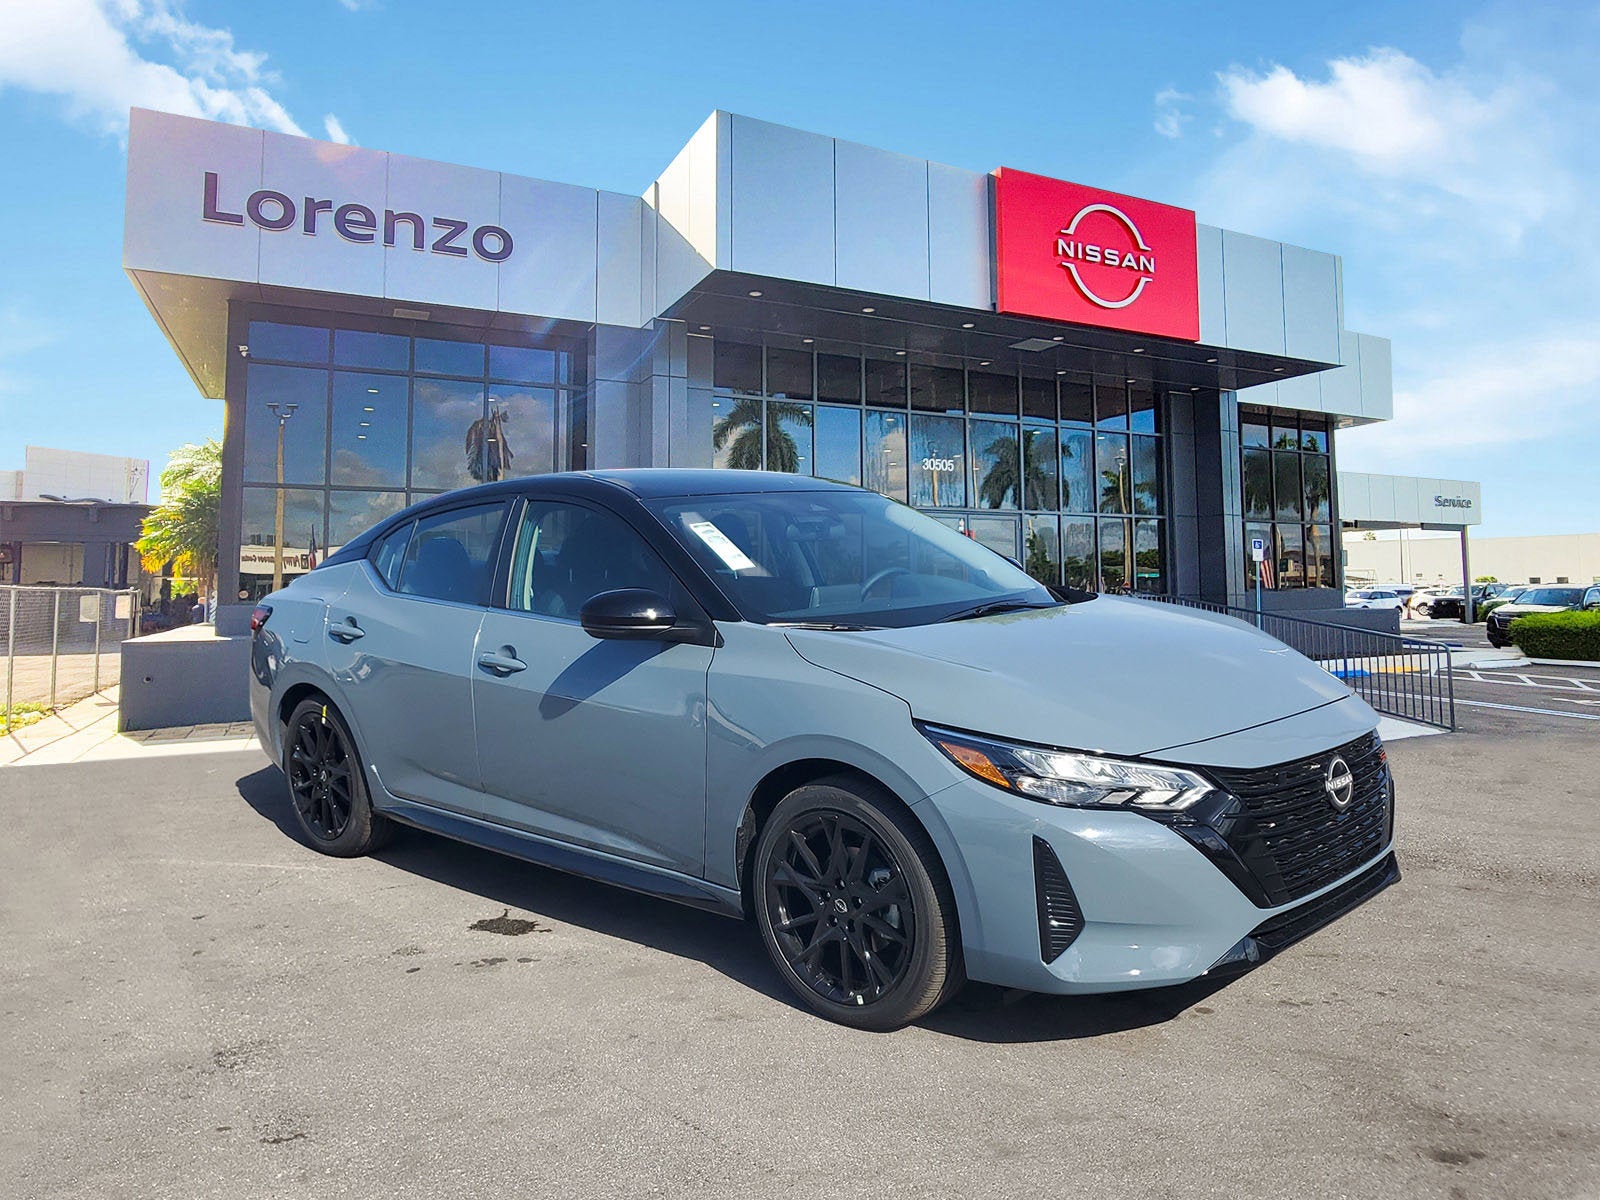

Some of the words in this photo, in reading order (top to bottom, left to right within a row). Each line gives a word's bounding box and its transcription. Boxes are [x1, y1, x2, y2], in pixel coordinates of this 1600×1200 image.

[202, 171, 514, 262] Lorenzo
[1057, 238, 1155, 273] NISSAN
[922, 457, 955, 472] 30505
[1434, 495, 1472, 508] Service
[1325, 773, 1353, 793] NISSAN
